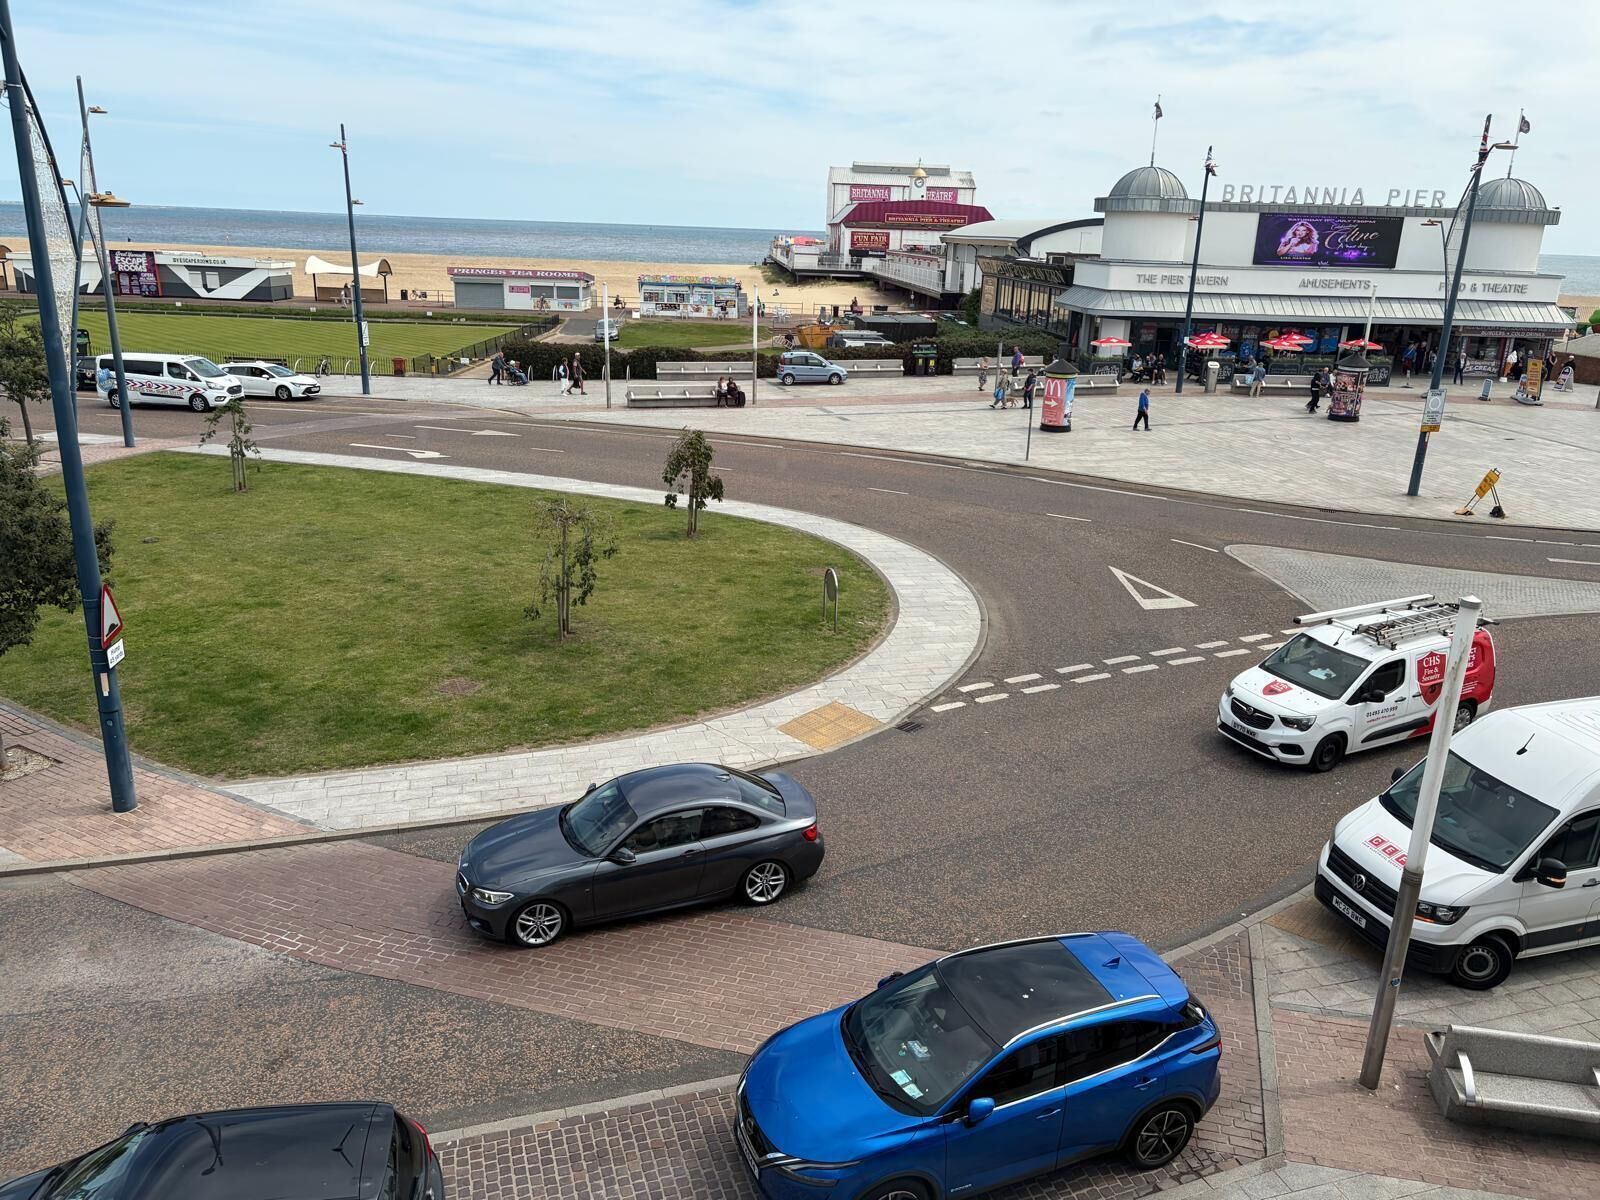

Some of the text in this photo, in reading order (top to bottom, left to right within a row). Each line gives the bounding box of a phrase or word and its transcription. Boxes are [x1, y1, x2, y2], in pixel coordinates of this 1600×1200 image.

[852, 188, 889, 200] BRITANNIA
[926, 190, 953, 201] HEATRE
[1222, 184, 1446, 208] BRITANNIA PIER
[115, 256, 148, 265] ESCAPE
[118, 263, 148, 272] ROOMS
[1136, 273, 1157, 285] THE
[1160, 274, 1184, 285] PIER
[1298, 278, 1371, 290] AMUSEMENTS
[1470, 283, 1478, 293] &
[1481, 283, 1529, 294] THEATRE
[1473, 364, 1498, 373] CREAM
[1423, 655, 1440, 668] CHS
[1422, 673, 1440, 682] Security
